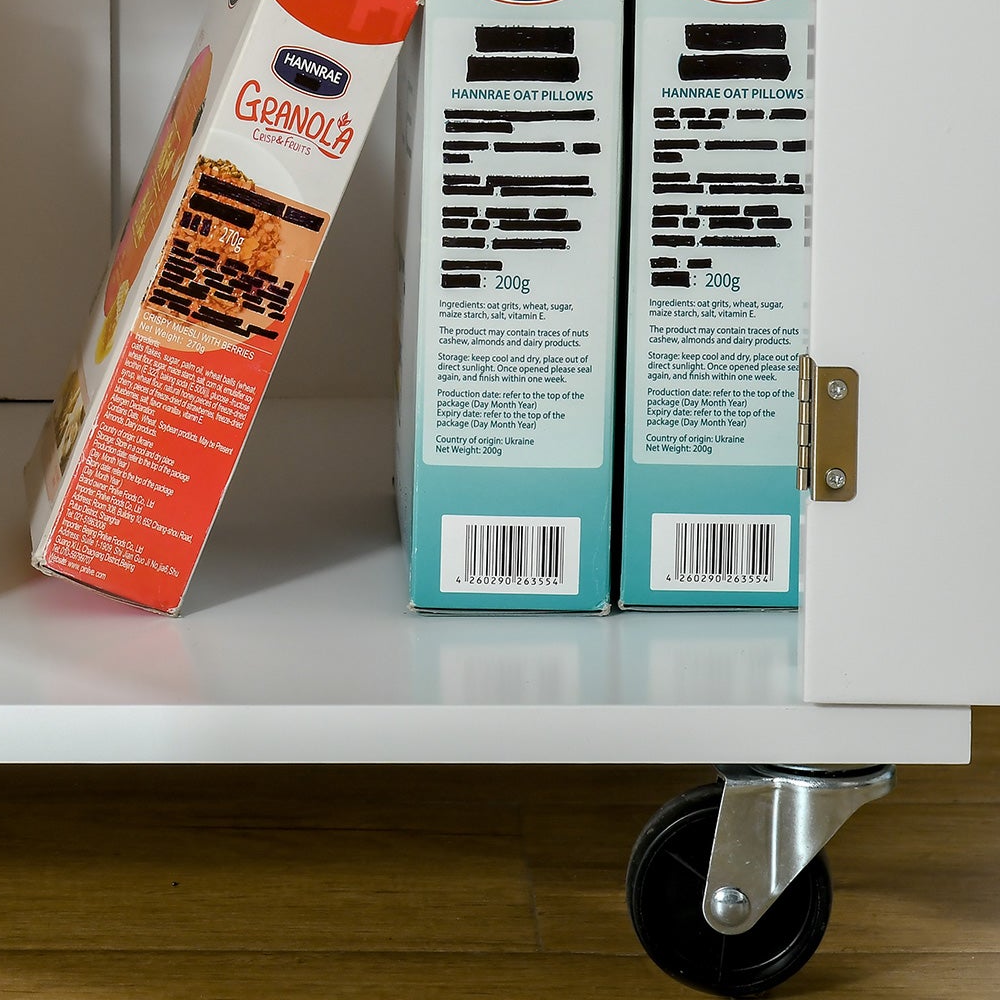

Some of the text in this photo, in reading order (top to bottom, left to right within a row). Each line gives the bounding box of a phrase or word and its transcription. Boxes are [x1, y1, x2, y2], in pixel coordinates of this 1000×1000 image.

[284, 53, 342, 84] HANNRAE
[452, 88, 594, 101] HANNRAE OAT PILLOWS
[662, 88, 804, 99] HANNRAE OAT PILLOWS
[235, 80, 354, 154] GRANOLA
[219, 227, 245, 253] 270g
[496, 275, 530, 294] 200g
[706, 273, 740, 292] 200g
[439, 300, 485, 310] Ingredients:
[501, 302, 520, 311] grits,
[522, 302, 548, 311] wheat,
[550, 304, 573, 312] sugar,
[649, 298, 695, 309] Ingredients:
[711, 300, 731, 309] grits,
[732, 300, 758, 309] wheat,
[760, 302, 783, 310] sugar,
[438, 310, 545, 320] maize starch, salt, vitamin E.
[673, 309, 699, 318] starch,
[701, 309, 716, 318] salt,
[718, 310, 747, 318] vitamin
[749, 310, 755, 318] E.
[139, 322, 206, 354] Net Weight: 270g
[143, 312, 254, 360] CRISPY MUESLI WITH BERRIES
[455, 327, 486, 337] product
[488, 329, 504, 337] may
[506, 328, 535, 336] contain
[438, 336, 580, 349] cashew, almonds and dairy products.
[437, 353, 469, 363] Storage:
[471, 353, 490, 363] keep
[491, 354, 508, 362] cool
[510, 354, 524, 362] and
[526, 355, 540, 364] dry,
[542, 355, 563, 365] place
[579, 356, 587, 364] of
[437, 363, 460, 371] direct
[462, 363, 495, 373] sunlight.
[496, 364, 517, 372] Once
[518, 364, 548, 374] opened
[550, 365, 575, 375] please
[647, 361, 670, 369] direct
[672, 362, 705, 372] sunlight.
[706, 362, 727, 370] Once
[728, 362, 759, 372] opened
[760, 363, 785, 373] please
[437, 373, 460, 382] again,
[462, 373, 477, 381] and
[478, 373, 499, 381] finish
[501, 374, 525, 382] within
[544, 375, 566, 383] week.
[437, 389, 480, 398] Production
[481, 390, 500, 398] date:
[502, 390, 520, 398] refer
[532, 391, 545, 399] the
[547, 392, 560, 401] top
[561, 392, 569, 400] of
[571, 392, 584, 400] the
[436, 399, 537, 411] package (Day Month Year)
[436, 409, 461, 419] Expiry
[462, 409, 481, 417] date:
[483, 410, 501, 418] refer
[513, 410, 526, 418] the
[527, 412, 541, 421] top
[542, 411, 550, 419] of
[552, 411, 565, 419] the
[436, 418, 536, 431] package (Day Month Year)
[435, 435, 534, 446] Country of origin: Ukraine
[645, 434, 744, 444] Country of origin: Ukraine
[435, 445, 502, 456] Net Weight: 200g
[645, 443, 712, 454] Net Weight: 200g
[470, 576, 511, 585] 260290
[516, 577, 558, 586] 263554
[680, 574, 721, 583] 260290
[727, 575, 768, 584] 263554
